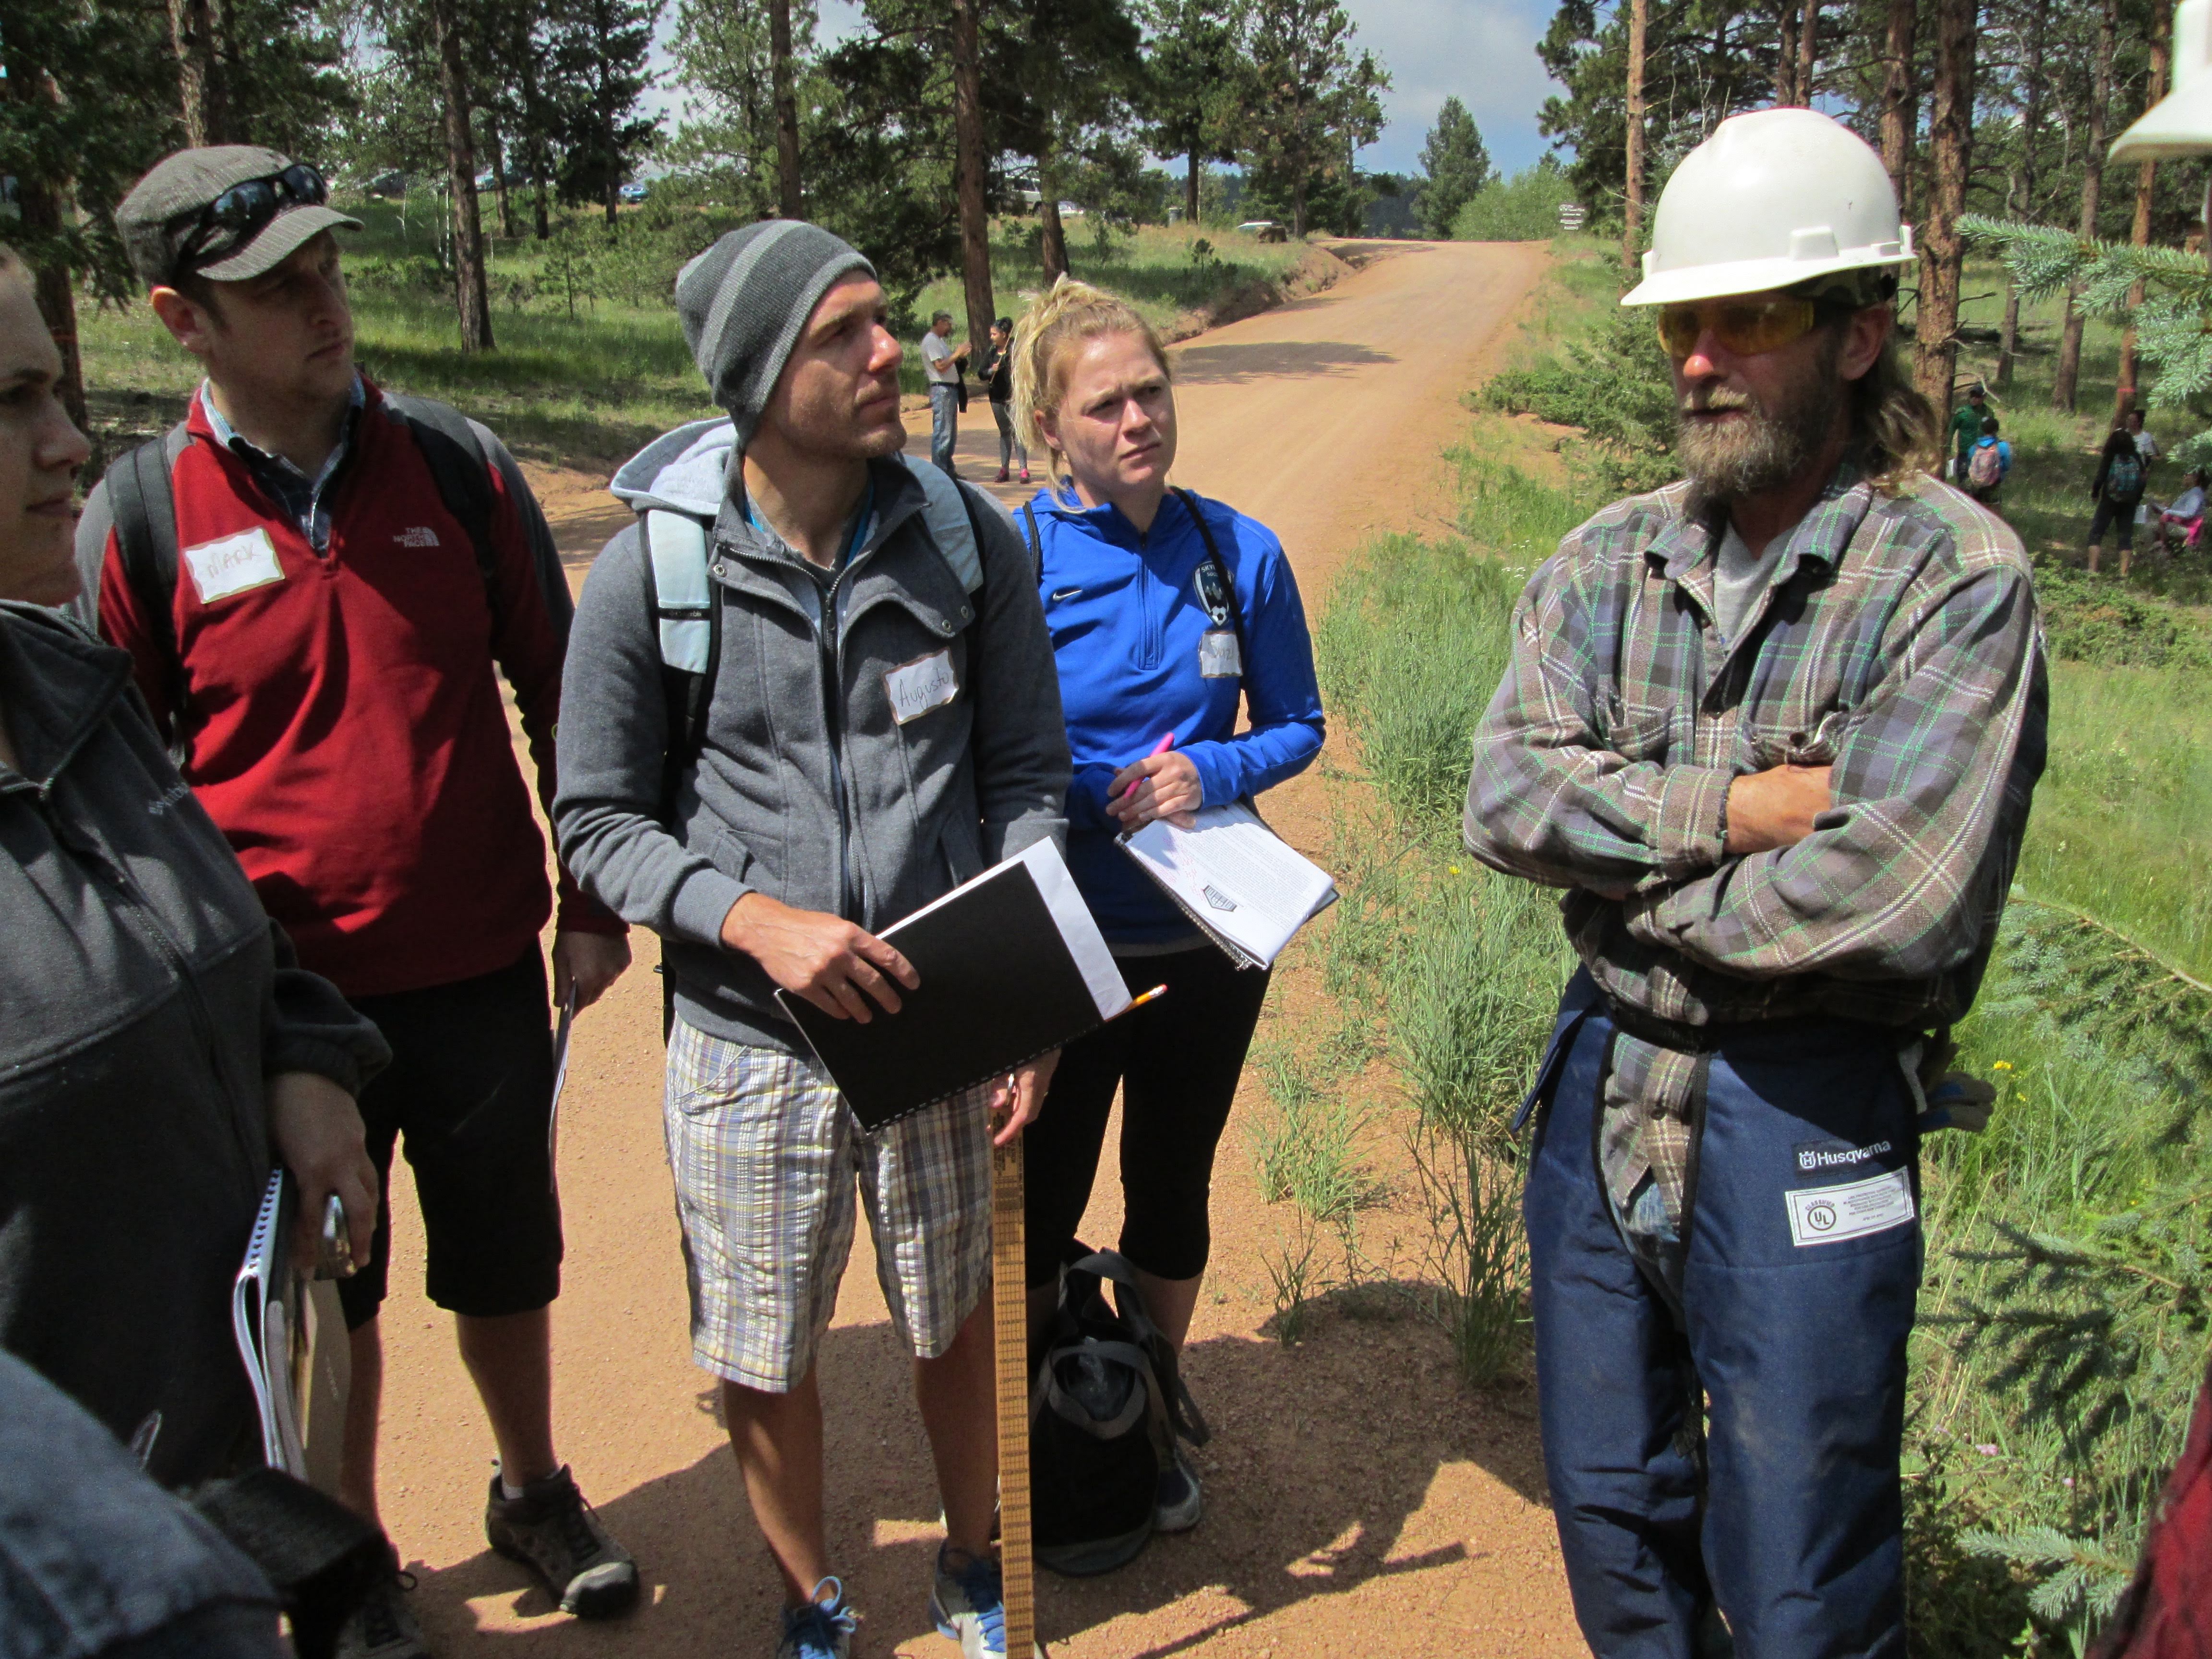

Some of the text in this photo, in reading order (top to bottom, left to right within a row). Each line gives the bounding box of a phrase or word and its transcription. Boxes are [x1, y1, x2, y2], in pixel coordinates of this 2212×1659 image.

[900, 668, 949, 710] Augusto
[1817, 1141, 1892, 1166] Husqvarna
[1814, 1211, 1829, 1225] UL
